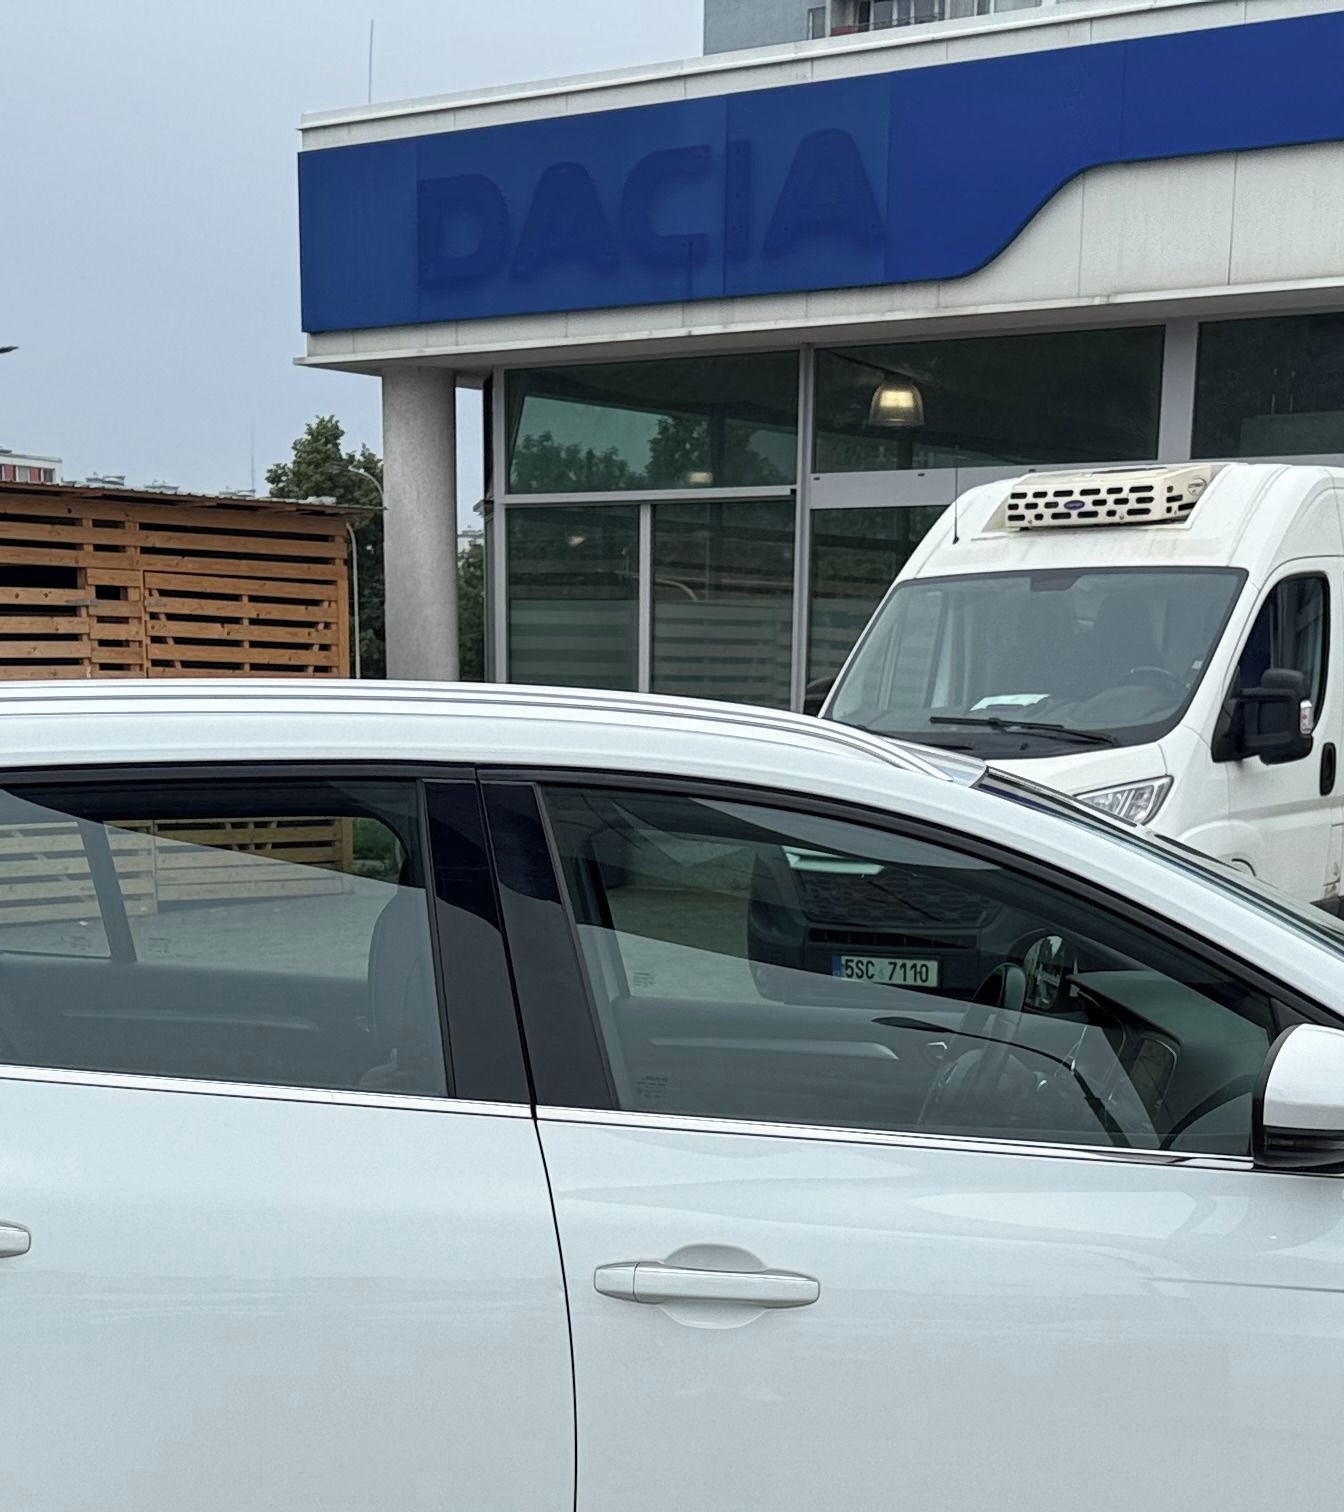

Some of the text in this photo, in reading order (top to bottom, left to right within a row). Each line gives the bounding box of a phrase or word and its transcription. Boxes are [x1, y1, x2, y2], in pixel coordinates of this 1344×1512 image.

[417, 128, 887, 285] DACIA
[845, 959, 929, 983] 5SC 7110
